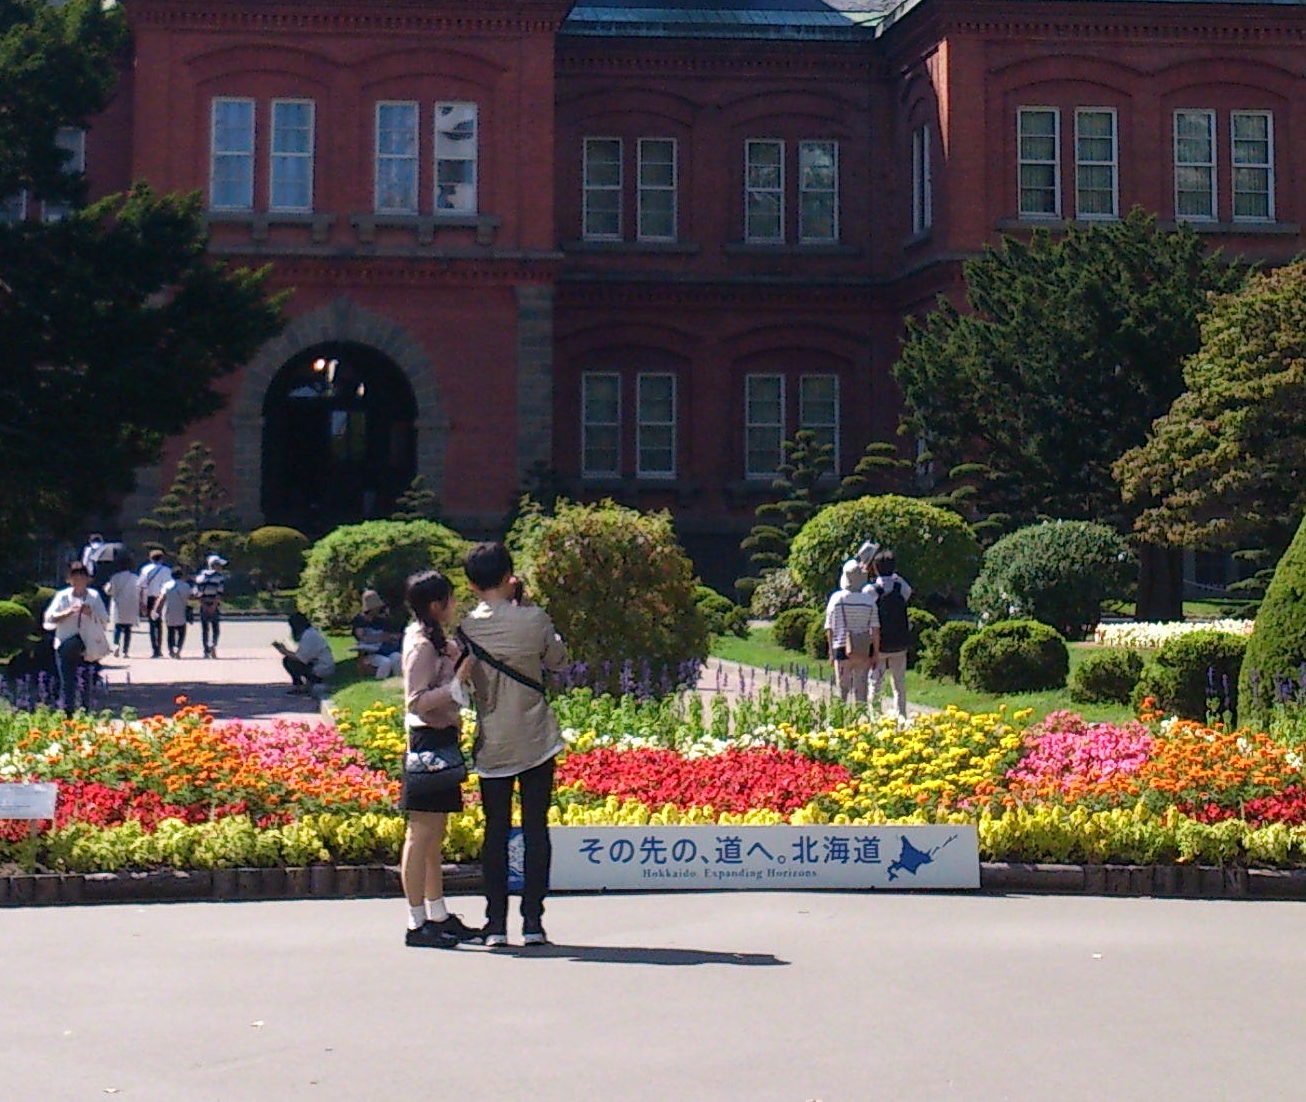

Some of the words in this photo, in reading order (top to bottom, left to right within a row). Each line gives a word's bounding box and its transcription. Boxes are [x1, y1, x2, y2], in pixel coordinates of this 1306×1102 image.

[579, 835, 881, 865] その先の、道へ。北海道
[704, 868, 763, 879] Expanding
[767, 868, 817, 878] Horizons
